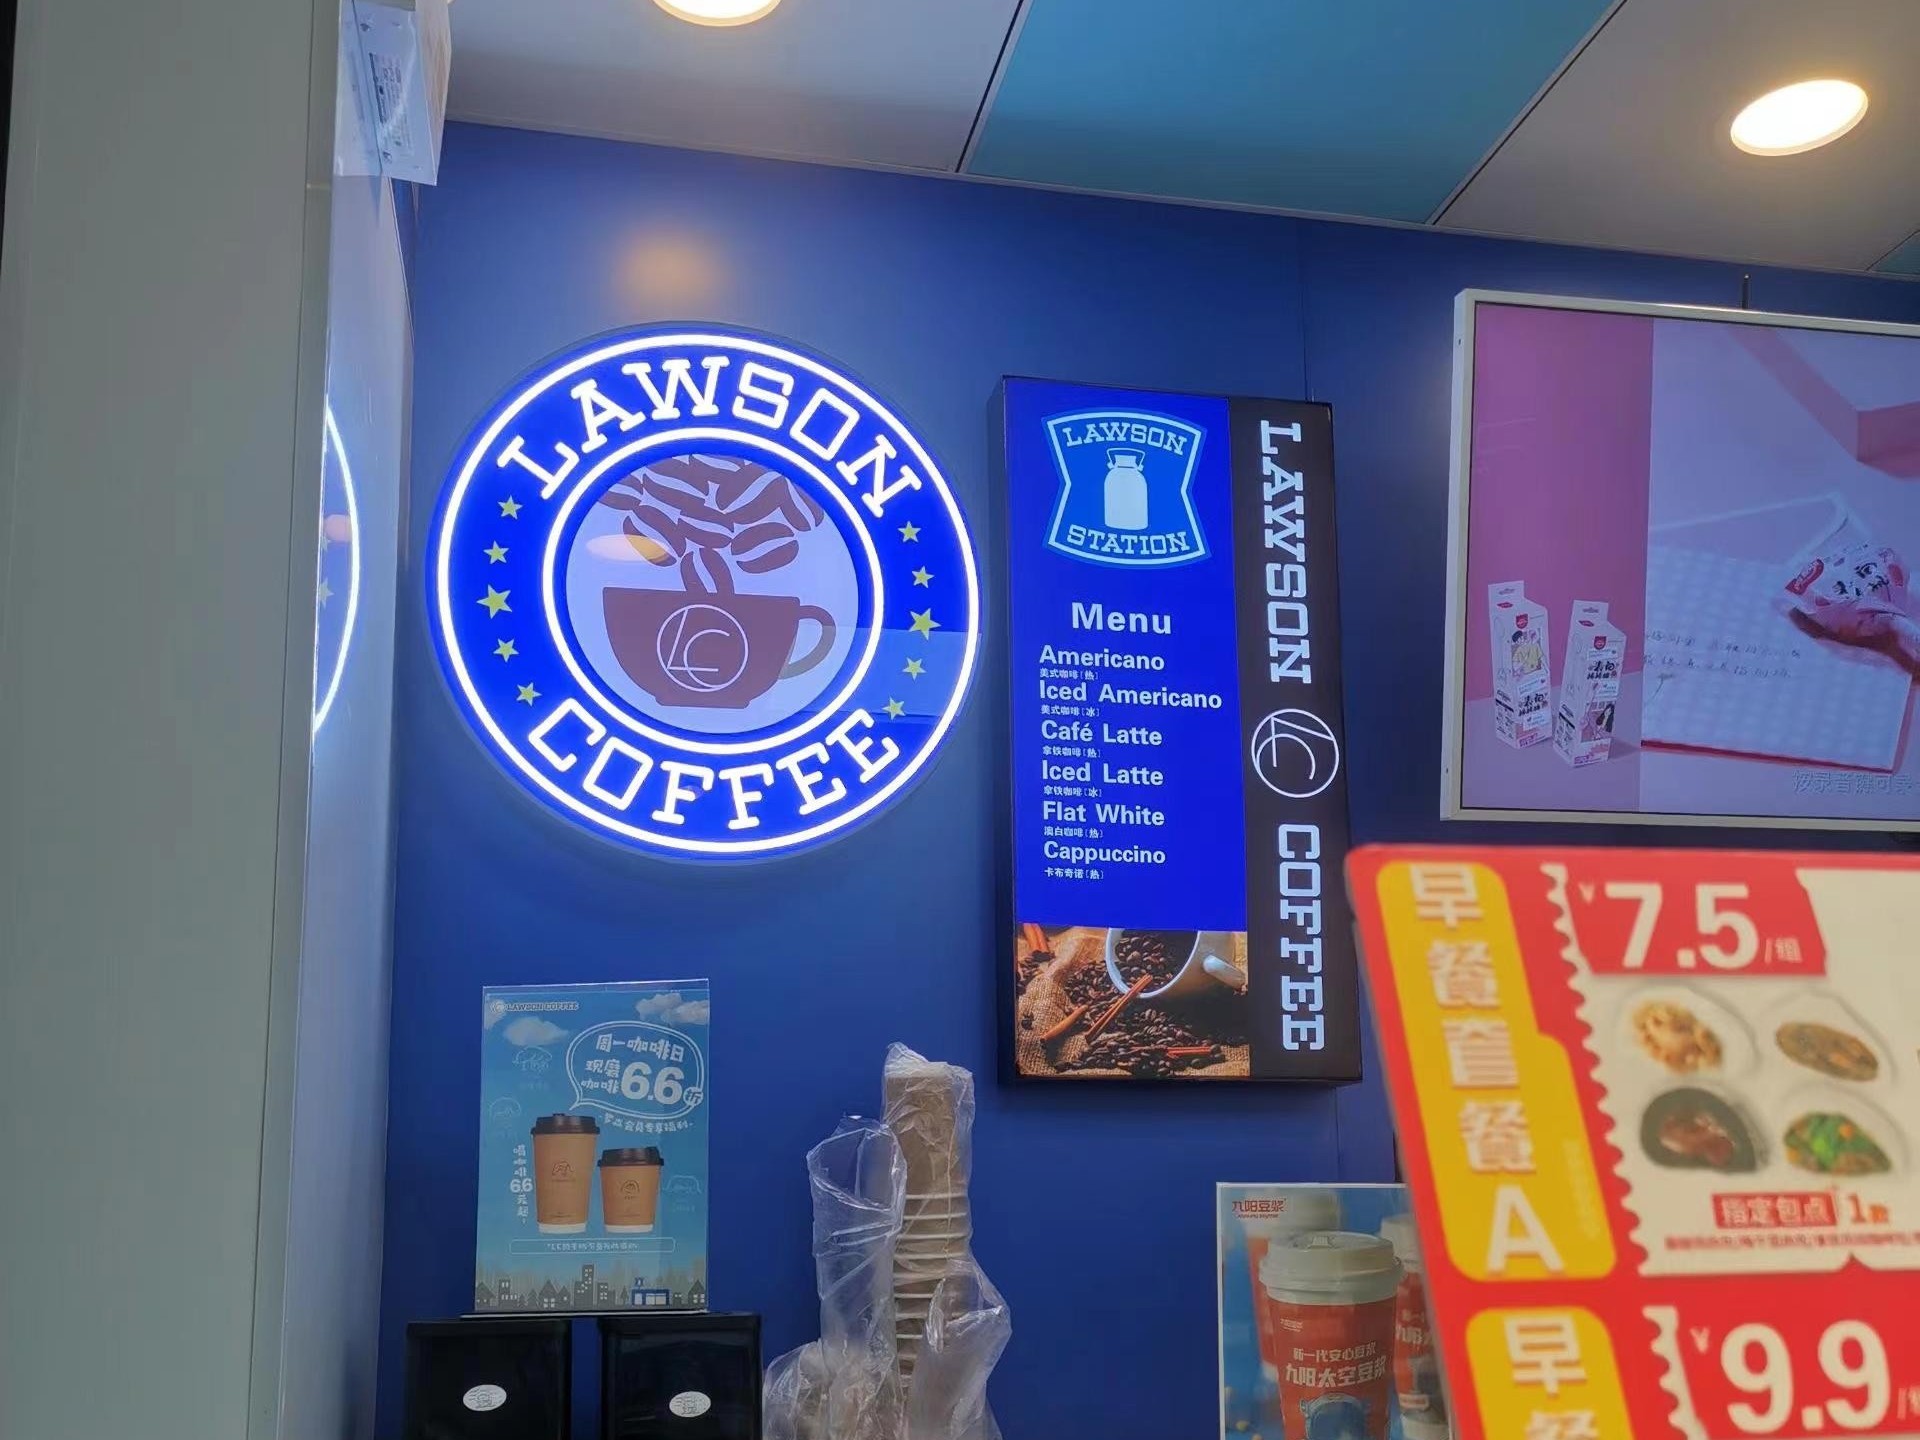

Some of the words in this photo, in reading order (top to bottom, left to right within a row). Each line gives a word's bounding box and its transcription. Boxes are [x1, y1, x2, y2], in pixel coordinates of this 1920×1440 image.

[497, 356, 921, 517] LAWSON
[1062, 422, 1187, 455] LAWSON
[1067, 524, 1190, 555] STATION
[1260, 420, 1312, 684] LAWSON
[1072, 602, 1171, 634] Menu
[1039, 644, 1165, 671] Americano
[1039, 680, 1087, 701] Iced
[1099, 683, 1222, 709] Americano
[1041, 719, 1093, 742] Café
[1103, 723, 1163, 746] Latte
[528, 697, 900, 829] COFFEE
[1042, 759, 1091, 782] Iced
[1103, 763, 1164, 786] Latte
[1043, 800, 1087, 822] Flat
[1095, 803, 1165, 826] White
[1043, 840, 1166, 865] Cappuccino
[1277, 823, 1326, 1050] COFFEE
[596, 1033, 685, 1062] 周一咖啡日
[581, 1077, 620, 1095] 咖啡
[1231, 1199, 1285, 1213] 九阳豆浆
[1293, 1340, 1377, 1363] 新一代安心豆浆
[1286, 1355, 1387, 1388] 九阳太空豆浆
